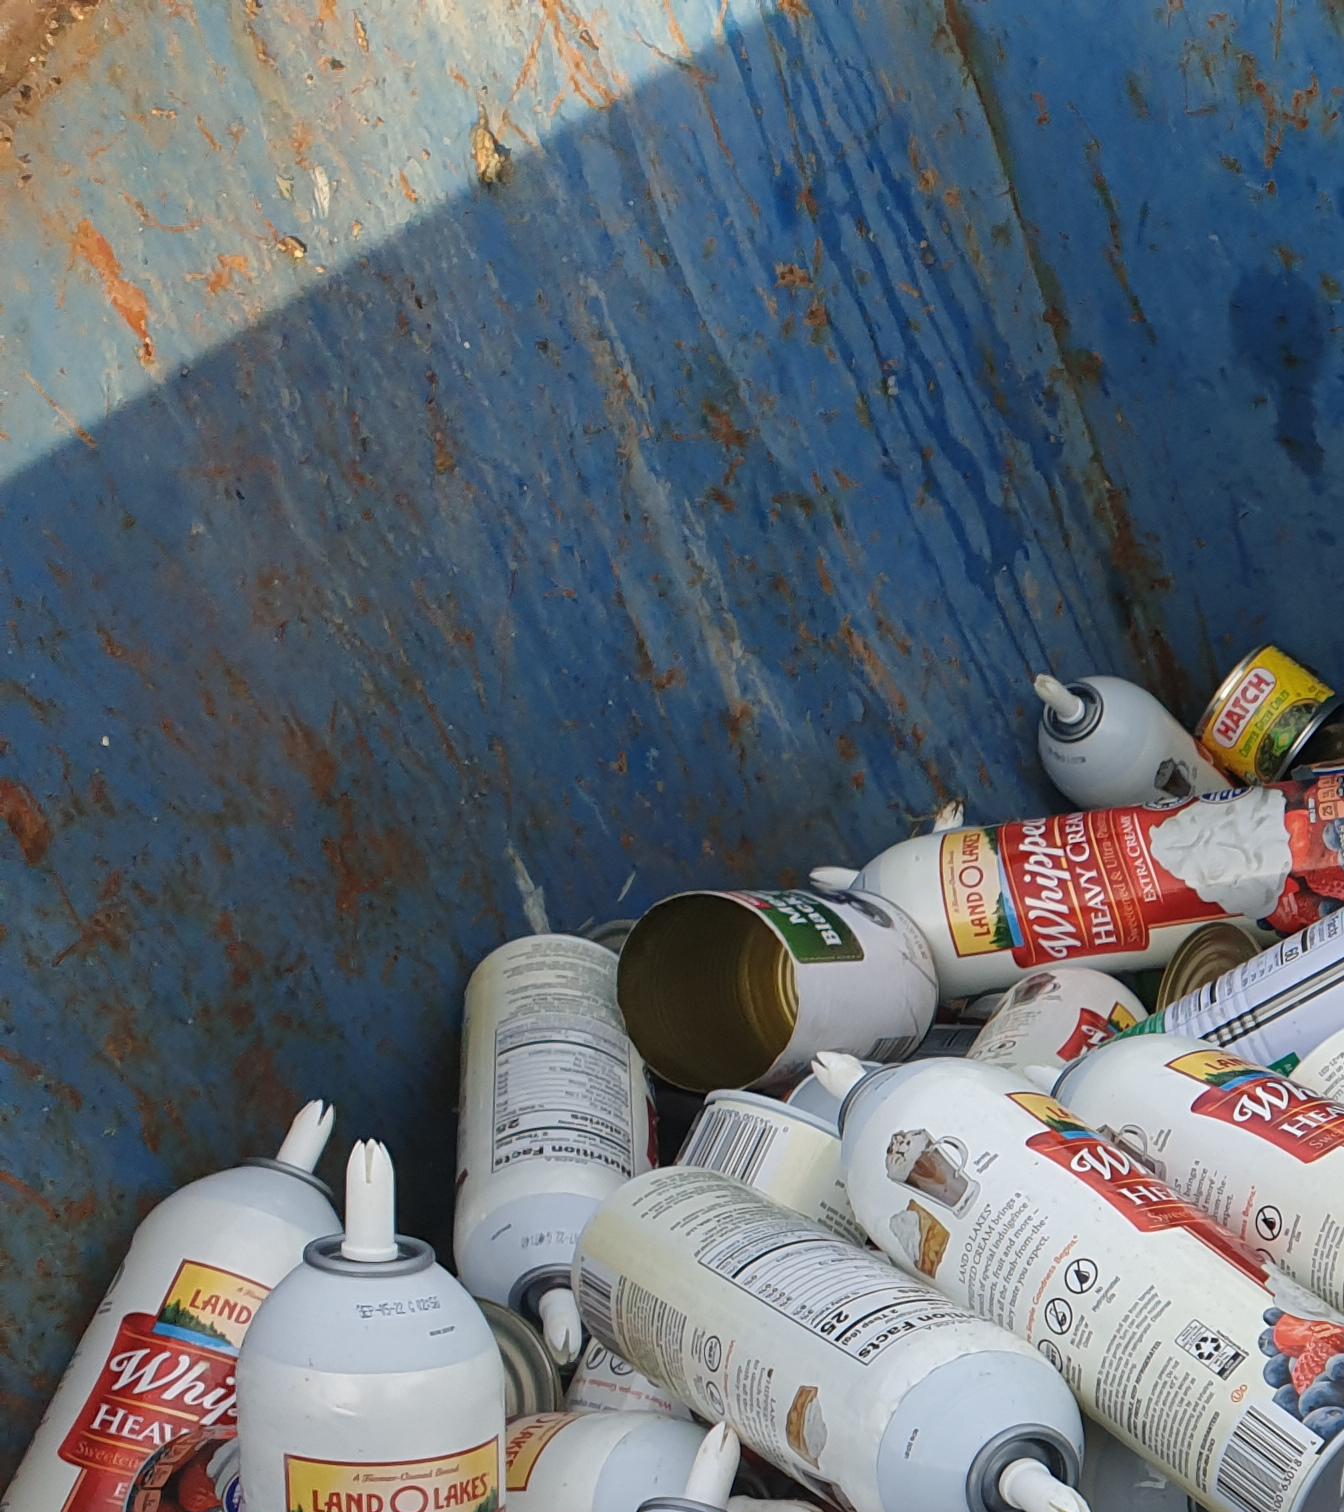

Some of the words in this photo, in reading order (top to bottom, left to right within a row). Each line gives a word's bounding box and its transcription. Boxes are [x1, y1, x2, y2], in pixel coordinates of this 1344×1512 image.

[1216, 673, 1271, 741] HATCH
[962, 832, 981, 864] LAKES
[1133, 858, 1157, 902] EXTRA
[967, 892, 991, 937] LAND
[1075, 868, 1117, 946] HEAVY
[1112, 881, 1140, 943] Sweetened
[433, 1472, 488, 1510] LAKES
